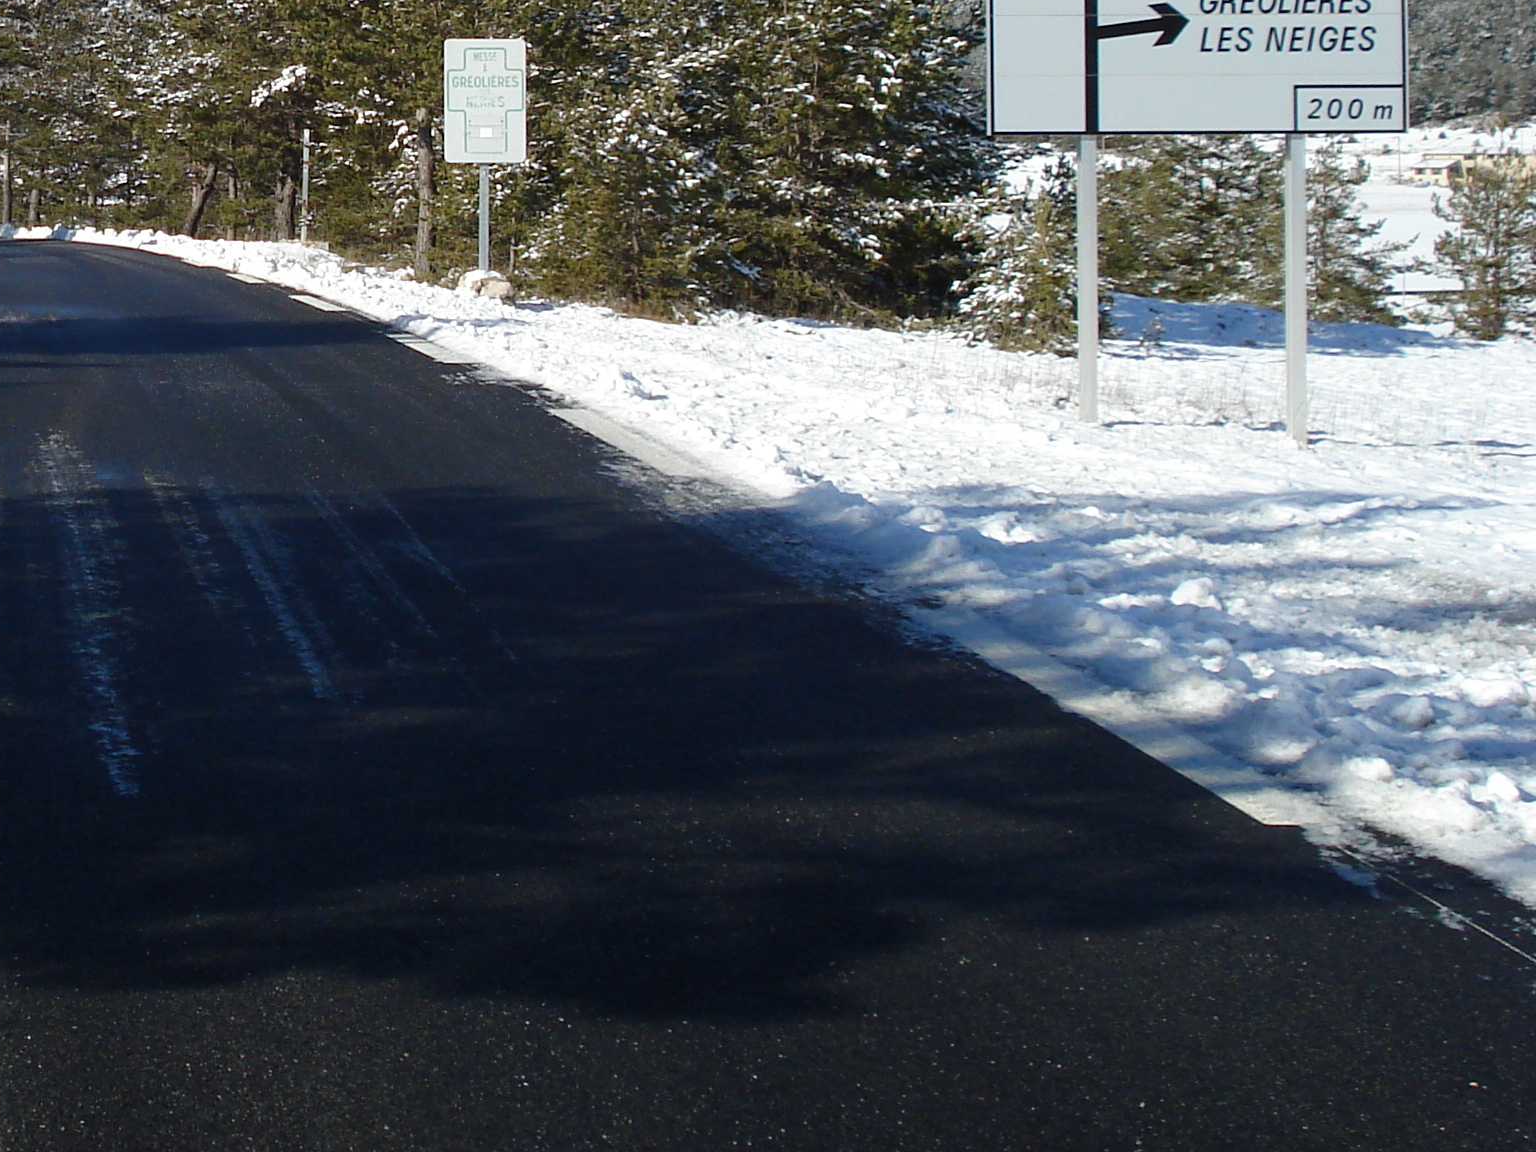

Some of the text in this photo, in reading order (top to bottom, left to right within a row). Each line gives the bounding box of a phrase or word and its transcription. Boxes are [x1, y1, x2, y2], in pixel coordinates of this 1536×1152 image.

[1199, 25, 1377, 53] LES NEIGES
[1307, 98, 1394, 121] 200 m
